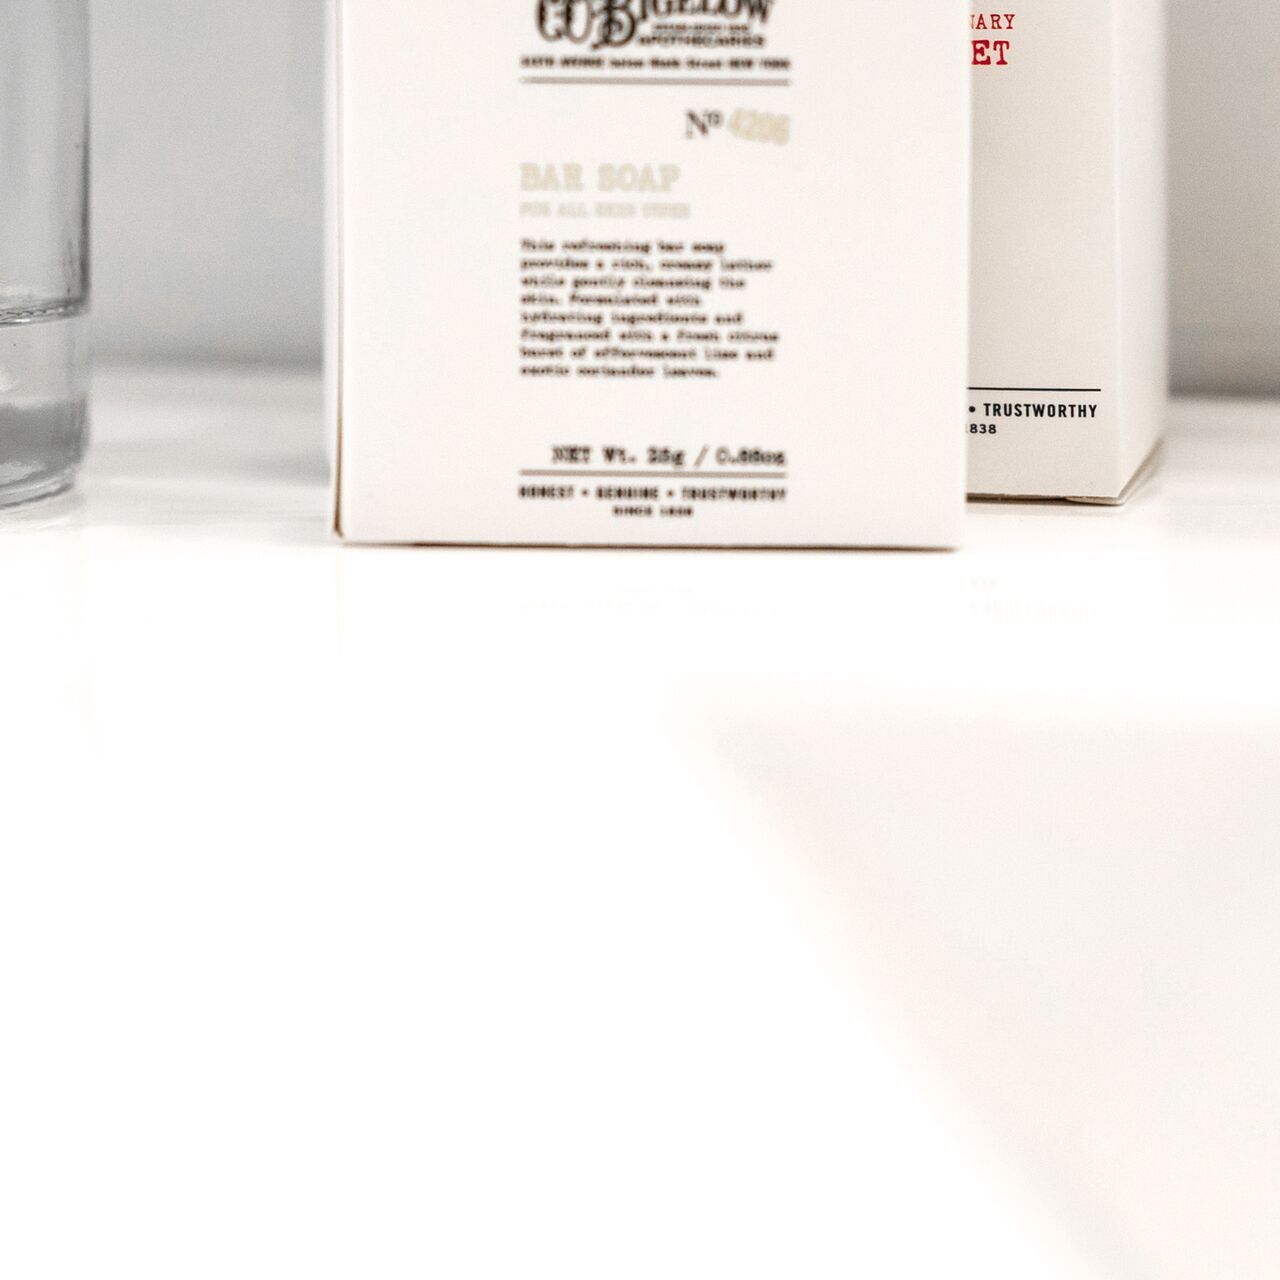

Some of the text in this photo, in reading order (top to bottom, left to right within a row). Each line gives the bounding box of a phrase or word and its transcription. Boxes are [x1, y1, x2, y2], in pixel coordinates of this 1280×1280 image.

[970, 14, 1015, 30] ARY
[520, 162, 680, 192] BAR SOAP
[520, 240, 724, 254] This refreshing bar soap
[520, 260, 588, 270] provides
[660, 262, 712, 271] creamy
[721, 260, 772, 270] lather
[520, 277, 745, 290] while gently cleansing the
[667, 295, 700, 304] with
[520, 312, 742, 324] hydrating ingredients and
[520, 330, 610, 341] fragranced
[620, 330, 652, 340] with
[678, 330, 720, 340] fresh
[728, 331, 778, 341] citrus
[520, 348, 774, 360] burst of effervescent lime and
[520, 365, 568, 376] exotic
[578, 365, 654, 376] coriander
[982, 402, 1098, 418] TRUSTWORTHY
[966, 423, 997, 434] 838
[552, 446, 590, 464] NET
[520, 486, 786, 500] HONEST GENUINE TRUSTWORTHY
